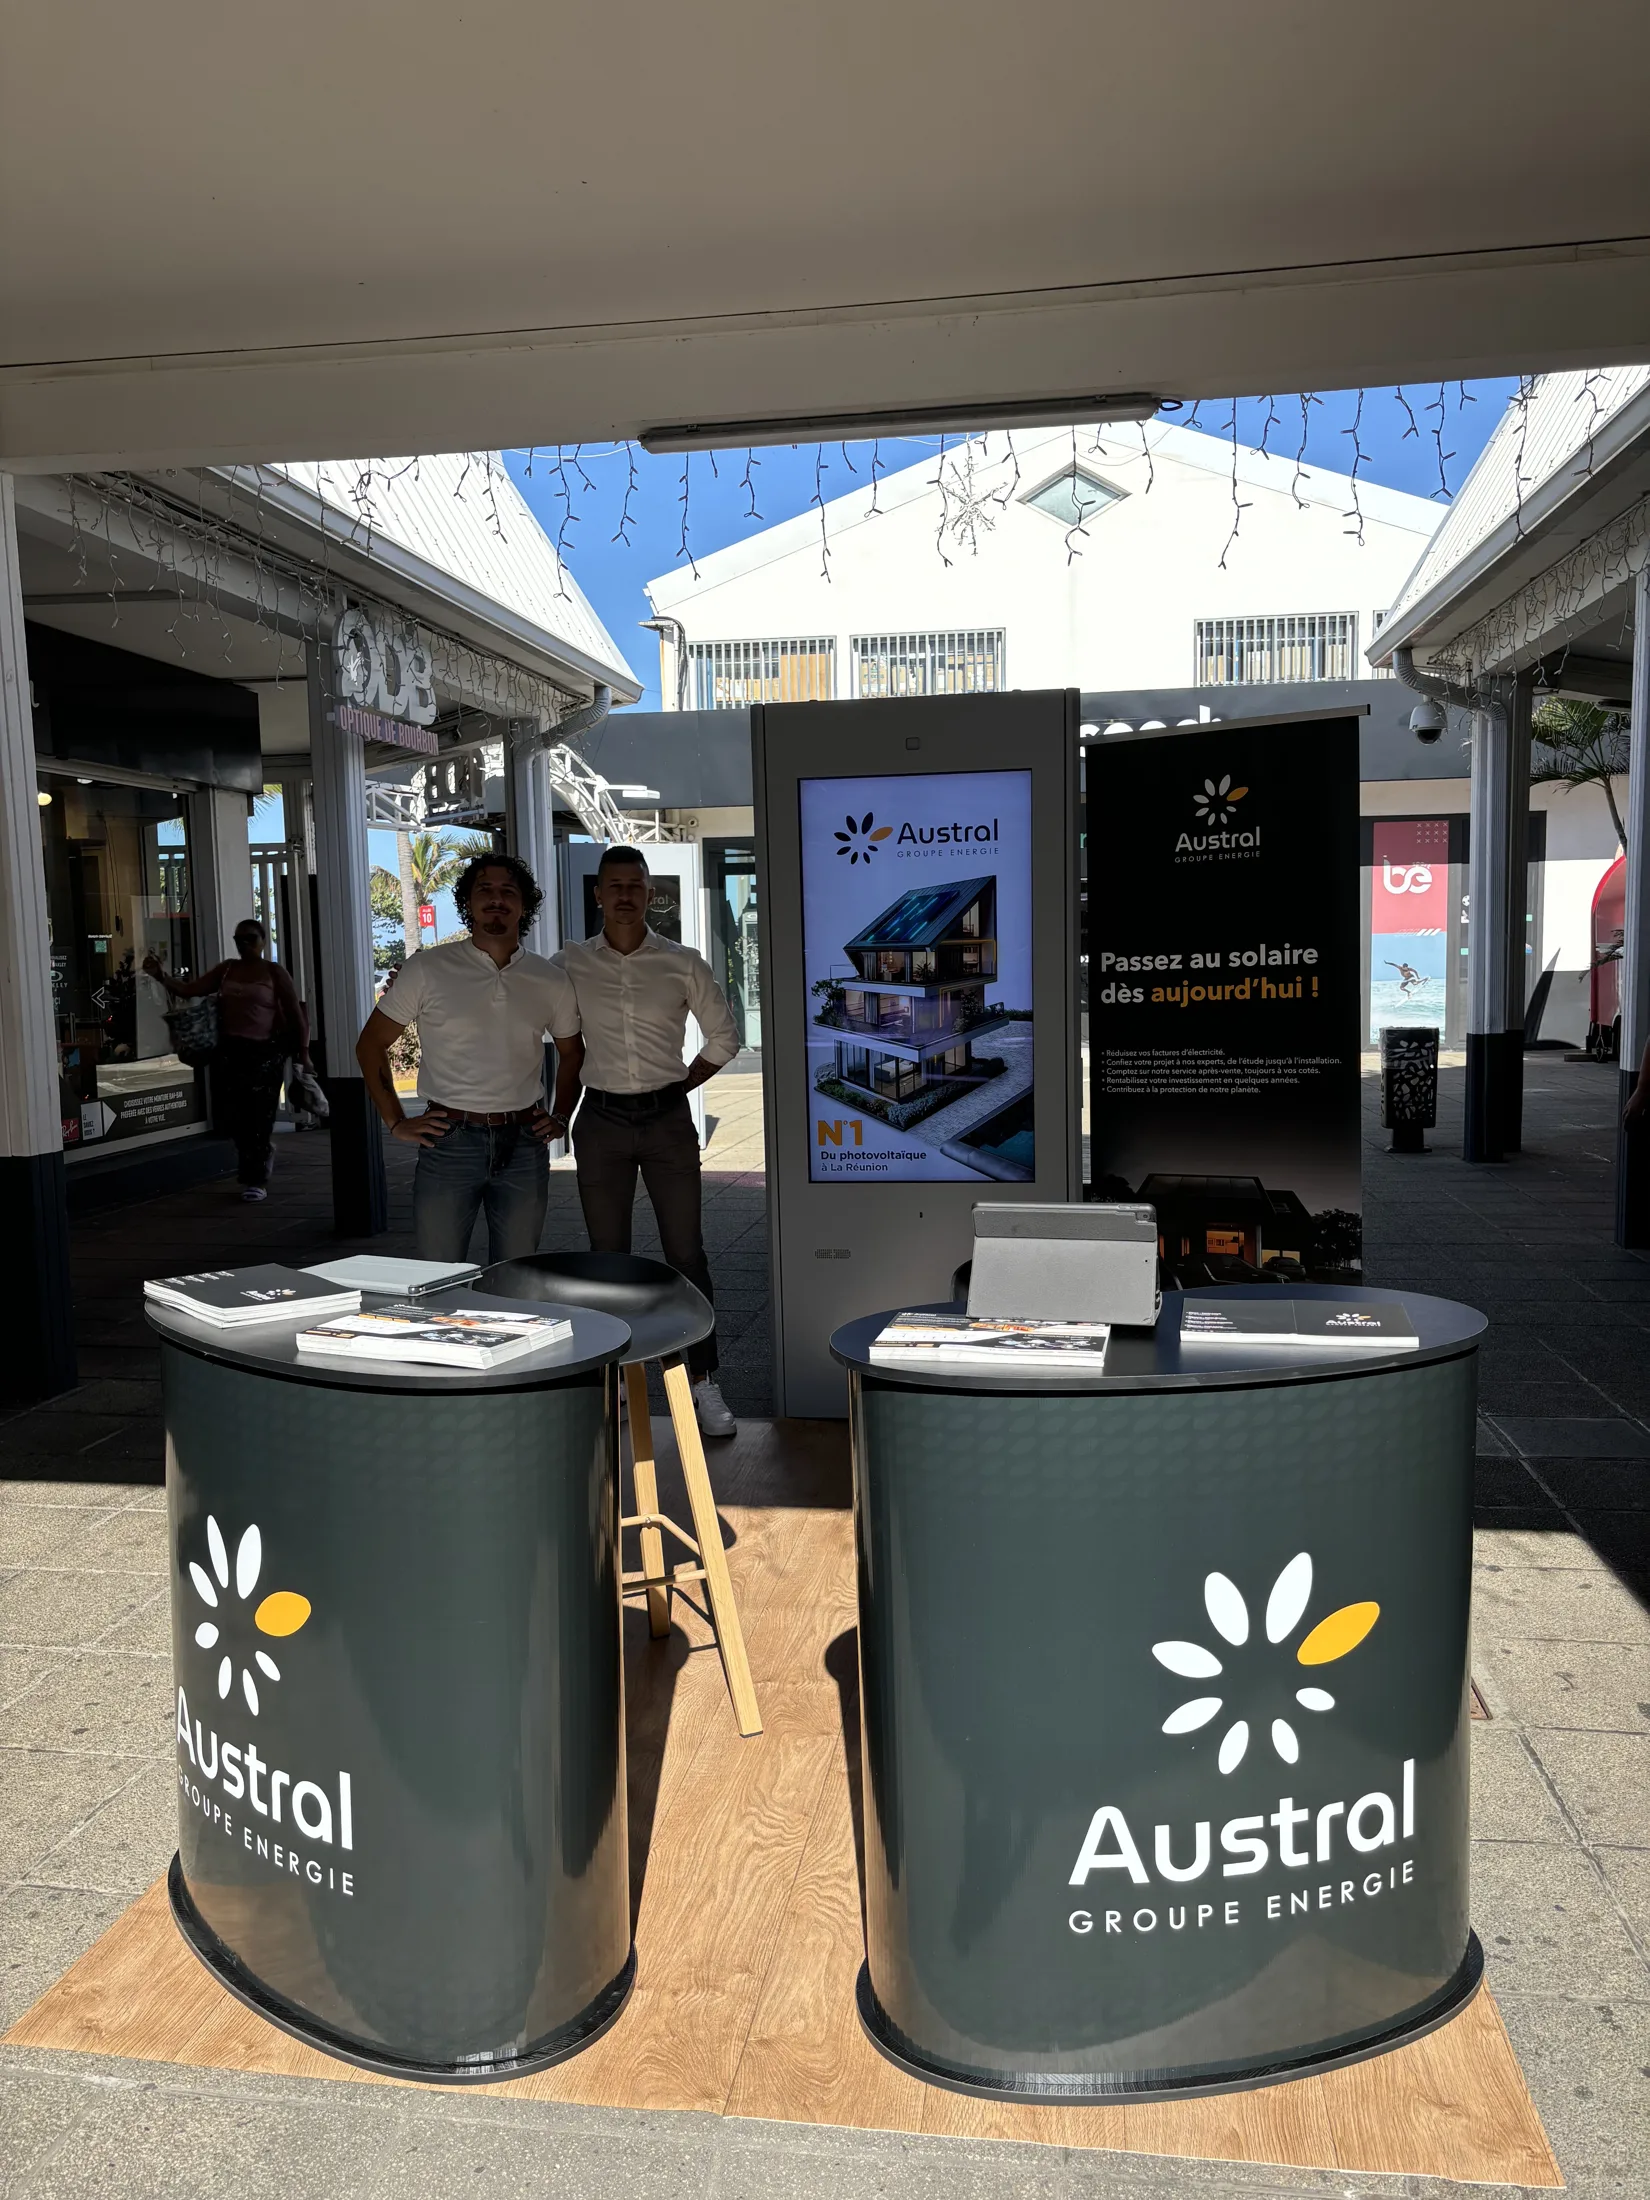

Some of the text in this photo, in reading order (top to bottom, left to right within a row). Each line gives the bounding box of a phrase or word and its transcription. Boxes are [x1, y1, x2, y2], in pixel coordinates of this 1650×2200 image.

[335, 608, 438, 726] ODB
[340, 705, 439, 756] OPTIQUE DE BOURBON
[897, 818, 998, 844] Austral
[1175, 826, 1260, 852] Austral
[897, 847, 999, 858] GROUPE ENERGIE
[1174, 851, 1260, 863] GROUPE ENERGIE
[1383, 857, 1433, 894] be
[422, 913, 432, 924] 10
[1101, 943, 1319, 973] Passez au solaire
[1101, 976, 1319, 1008] dès aujourd'hui !
[1106, 1049, 1137, 1057] Réduisez
[1152, 1048, 1180, 1057] factures
[1181, 1048, 1226, 1057] d'électricité.
[1106, 1058, 1132, 1066] Confiez
[1154, 1058, 1175, 1068] projet
[1176, 1058, 1181, 1066] à
[1197, 1058, 1226, 1067] experts,
[1227, 1057, 1237, 1065] de
[1239, 1057, 1264, 1065] l'étude
[1265, 1057, 1292, 1067] jusqu'à
[1294, 1057, 1342, 1065] l'installation.
[1106, 1067, 1138, 1077] Comptez
[1172, 1067, 1197, 1075] service
[1198, 1067, 1243, 1076] après-vente,
[1245, 1067, 1276, 1076] toujours
[1106, 1076, 1148, 1084] Rentabilisez
[1234, 1076, 1269, 1086] quelques
[1271, 1076, 1300, 1084] années.
[1106, 1085, 1145, 1093] Contribuez
[1146, 1085, 1151, 1093] à
[1152, 1085, 1159, 1093] la
[1160, 1086, 1197, 1095] protection
[1231, 1086, 1261, 1095] planète.
[818, 1120, 863, 1145] N°1
[821, 1150, 927, 1161] Du photovoltaïque
[821, 1162, 888, 1172] à La Réunion
[176, 1685, 353, 1850] Austral
[178, 1764, 354, 1896] GROUPE ENERGIE
[1068, 1758, 1414, 1886] Austral
[1069, 1860, 1414, 1934] GROUPE ENERGIE
